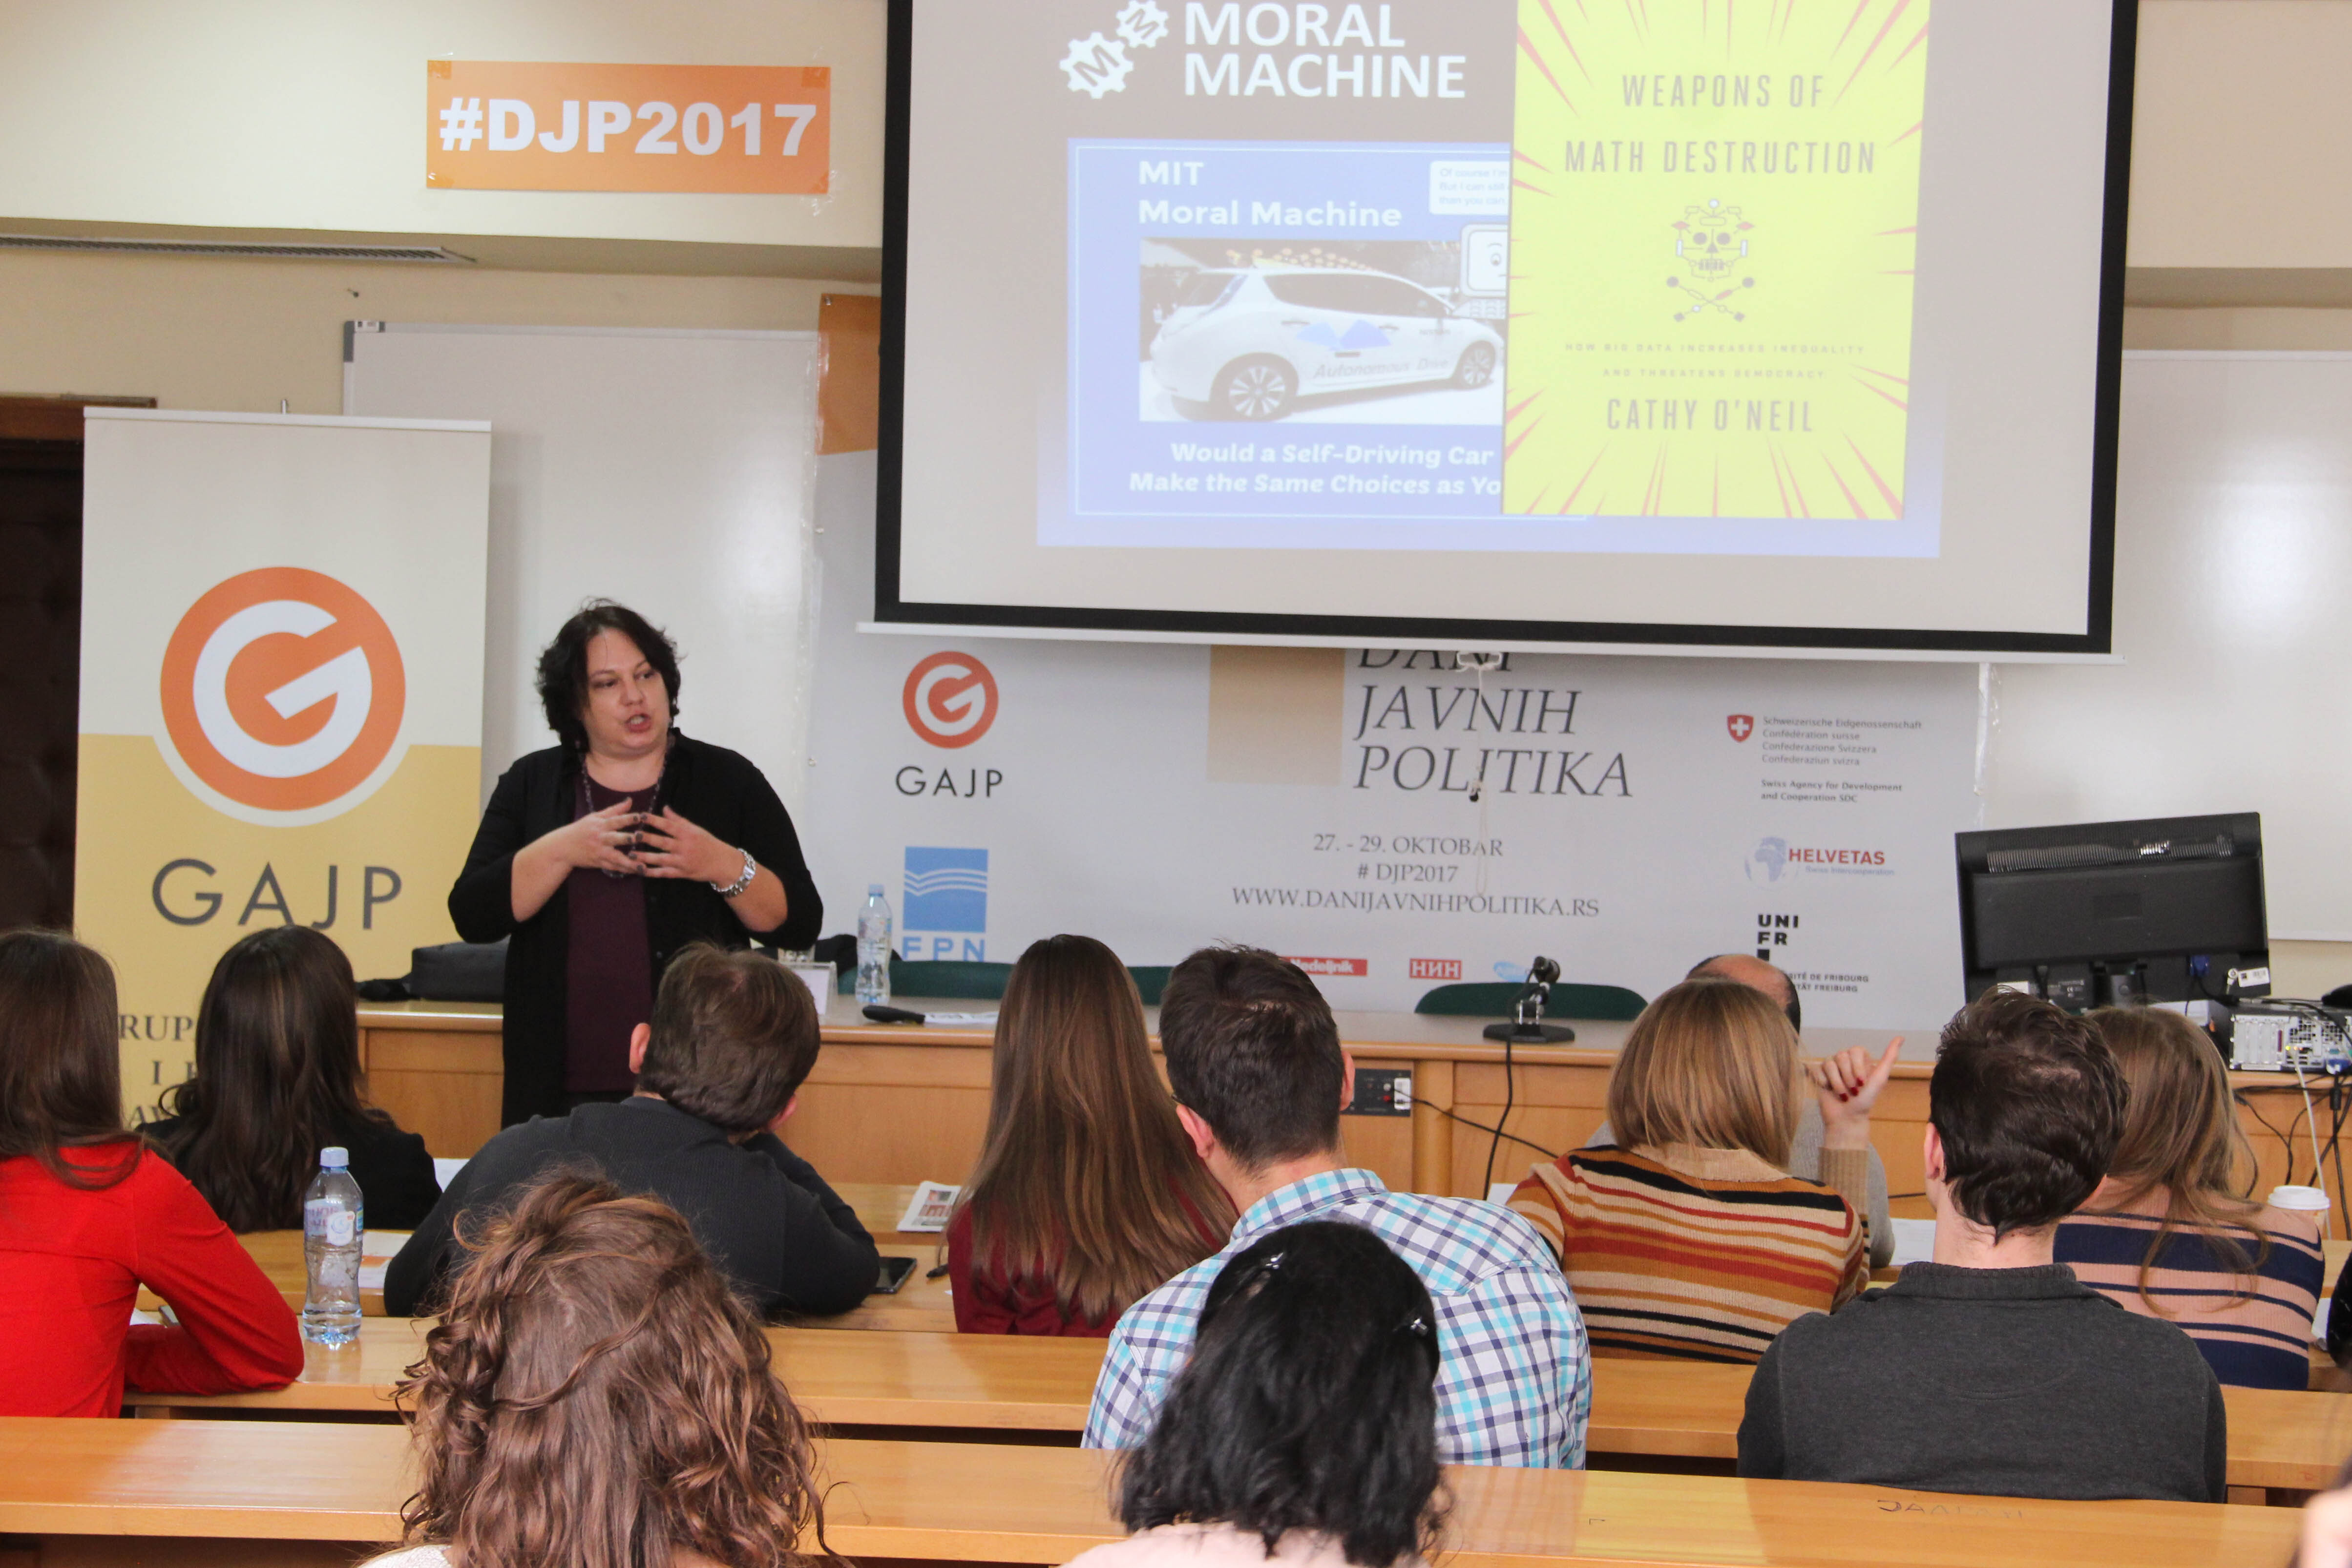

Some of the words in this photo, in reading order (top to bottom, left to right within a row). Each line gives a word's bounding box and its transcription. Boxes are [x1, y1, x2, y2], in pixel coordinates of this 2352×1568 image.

[1185, 2, 1405, 47] MORAL
[1185, 53, 1466, 98] MACHINE
[1622, 75, 1771, 107] WEAPONS
[1789, 75, 1824, 108] OF
[440, 97, 817, 156] #DJP2017
[1565, 140, 1644, 173] MATH
[1663, 141, 1874, 174] DESTRUCTION
[1139, 161, 1204, 186] MIT
[1139, 200, 1238, 225] Moral
[1251, 201, 1402, 228] Machine
[1565, 343, 1595, 352] HOW
[1637, 344, 1672, 352] DATA
[1680, 344, 1764, 353] INCREASES
[1773, 344, 1864, 354] INEQUALITY
[1313, 362, 1410, 378] Autonomous
[1639, 369, 1725, 378] THREATENS
[1734, 370, 1825, 379] DEMOCRACY
[1607, 399, 1698, 430] CATHY
[1714, 399, 1813, 432] O'NEIL
[1171, 443, 1255, 463] Would
[1261, 448, 1276, 463] a
[1282, 444, 1441, 468] Self-Driving
[1448, 446, 1494, 465] Car
[1130, 472, 1199, 493] Make
[1205, 473, 1248, 493] the
[1254, 474, 1323, 494] Same
[1330, 475, 1430, 495] Choices
[1437, 479, 1465, 495] as
[1353, 685, 1582, 740] JAVNIH
[1763, 716, 1832, 727] Schweizerische
[1835, 718, 1922, 729] Eidgenossenschaft
[1762, 741, 1835, 752] Confederazione
[1838, 743, 1877, 753] Svizzera
[1832, 732, 1860, 740] suisse
[1353, 745, 1633, 797] POLITIKA
[1762, 754, 1829, 765] Confederaziun
[895, 766, 1003, 798] GAJP
[1761, 779, 1786, 788] Swiss
[1790, 780, 1822, 790] Agency
[1826, 781, 1838, 790] for
[1842, 782, 1903, 792] Development
[1761, 792, 1778, 800] and
[1780, 793, 1836, 802] Cooperation
[1839, 794, 1858, 803] SDC
[1314, 834, 1341, 853] 27.
[1359, 836, 1386, 854] 29.
[1392, 836, 1504, 857] OKTOBAR
[1789, 848, 1886, 865] HELVETAS
[1375, 864, 1458, 885] DJP2017
[152, 858, 402, 931] GAJP
[1232, 888, 1599, 917] WWW.DANIJAVNIHPOLITIKA.RS
[1758, 914, 1799, 929] UNI
[902, 937, 986, 962] FPN
[1758, 932, 1787, 945] FR
[1411, 960, 1459, 977] НИН
[1824, 974, 1869, 983] FRIBOURG
[1815, 984, 1858, 992] FREIBURG
